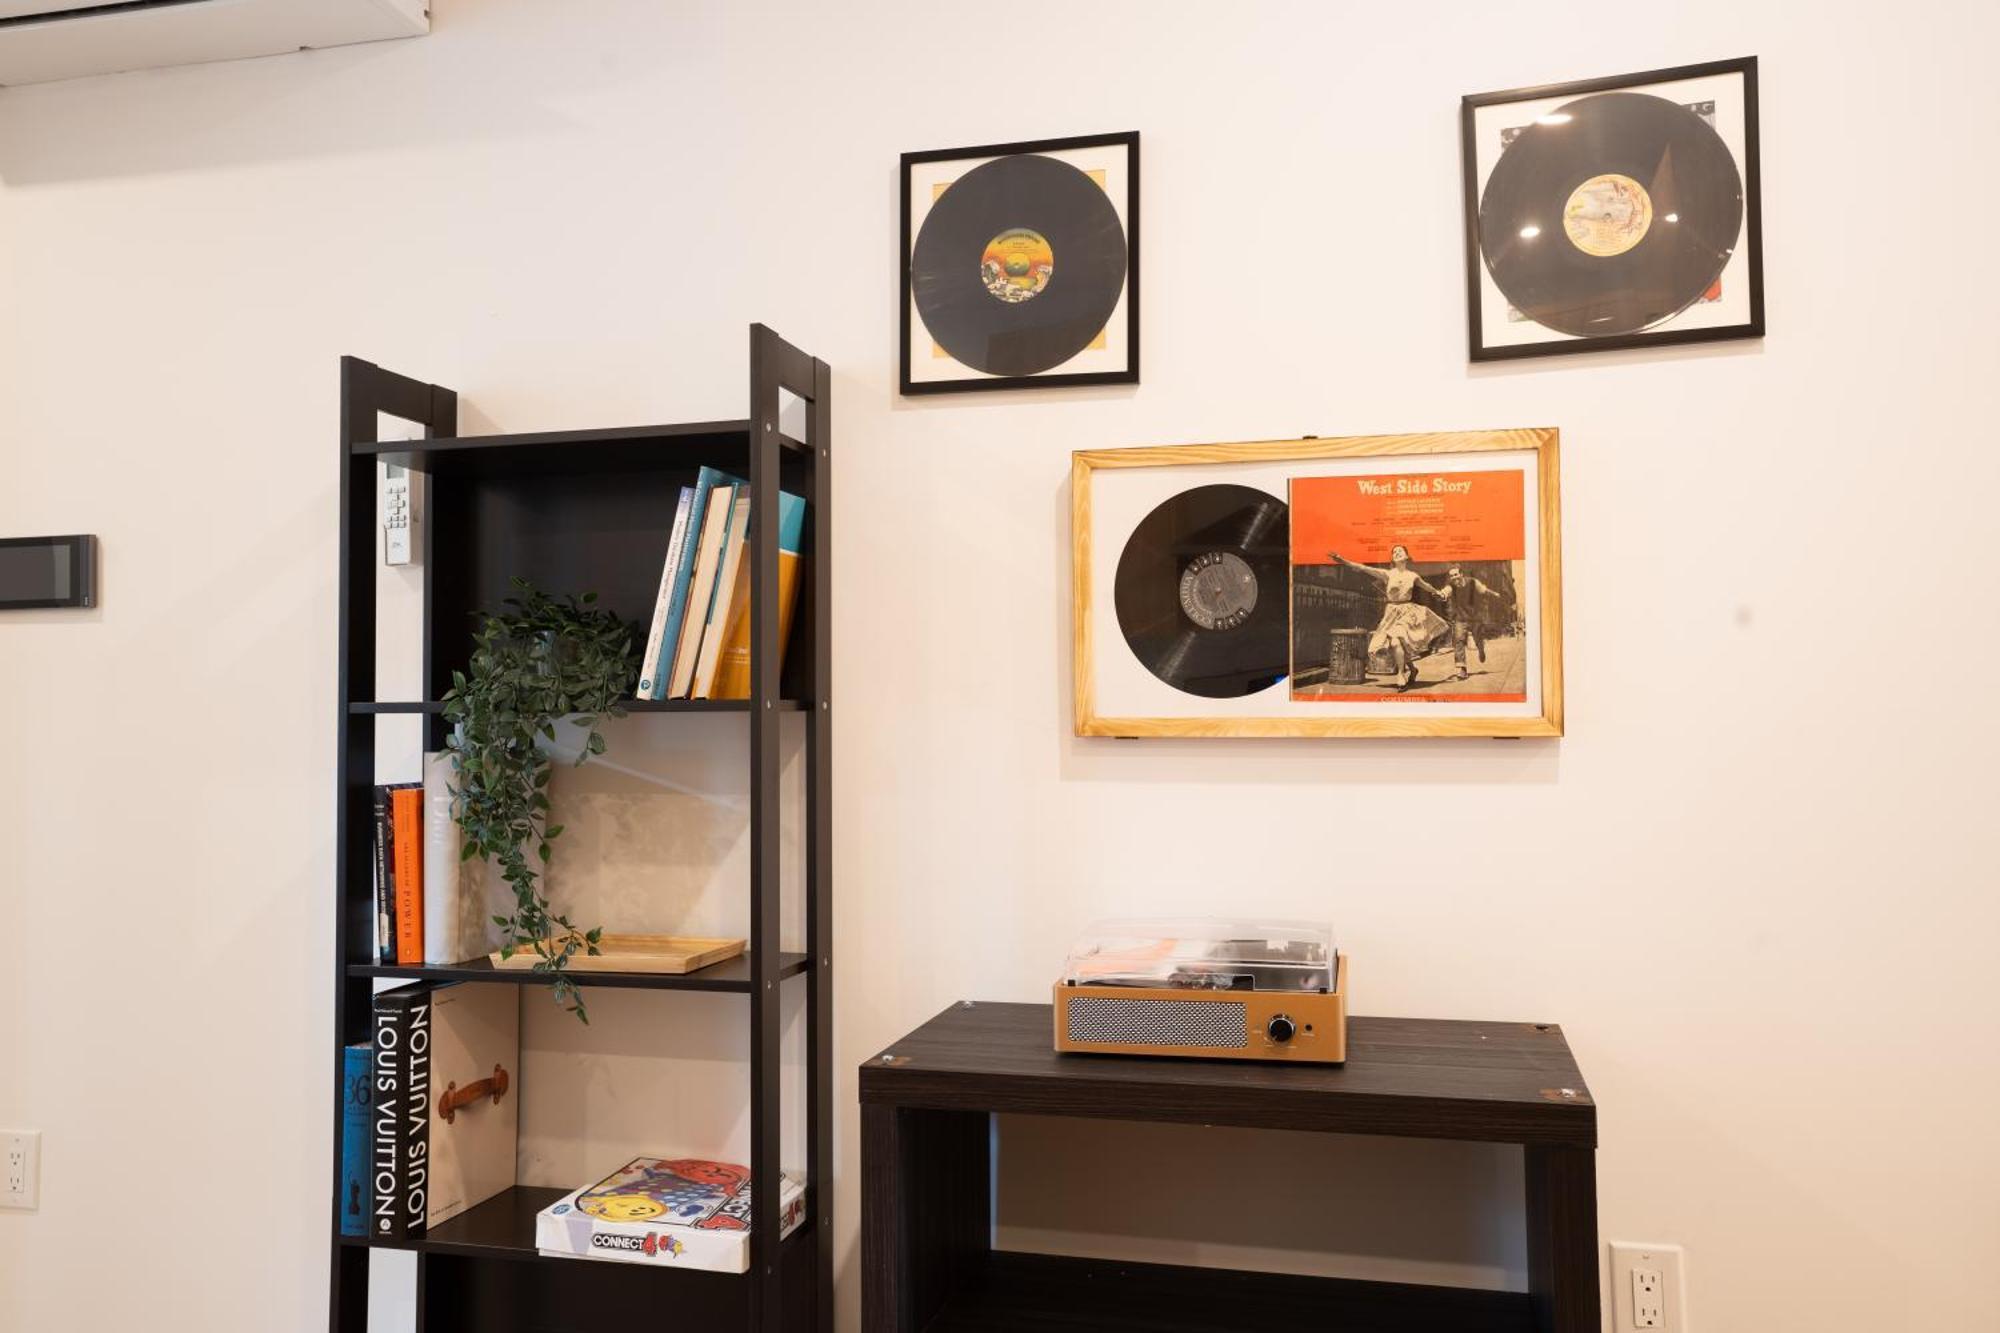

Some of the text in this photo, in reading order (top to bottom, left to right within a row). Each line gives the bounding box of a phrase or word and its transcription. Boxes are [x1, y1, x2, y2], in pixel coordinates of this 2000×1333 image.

[1357, 477, 1473, 496] West Side Story
[377, 1016, 398, 1091] LOUIS
[407, 1004, 429, 1229] LOUIS VUITTON
[375, 1099, 397, 1215] VUITTON
[593, 1235, 645, 1250] CONNECT
